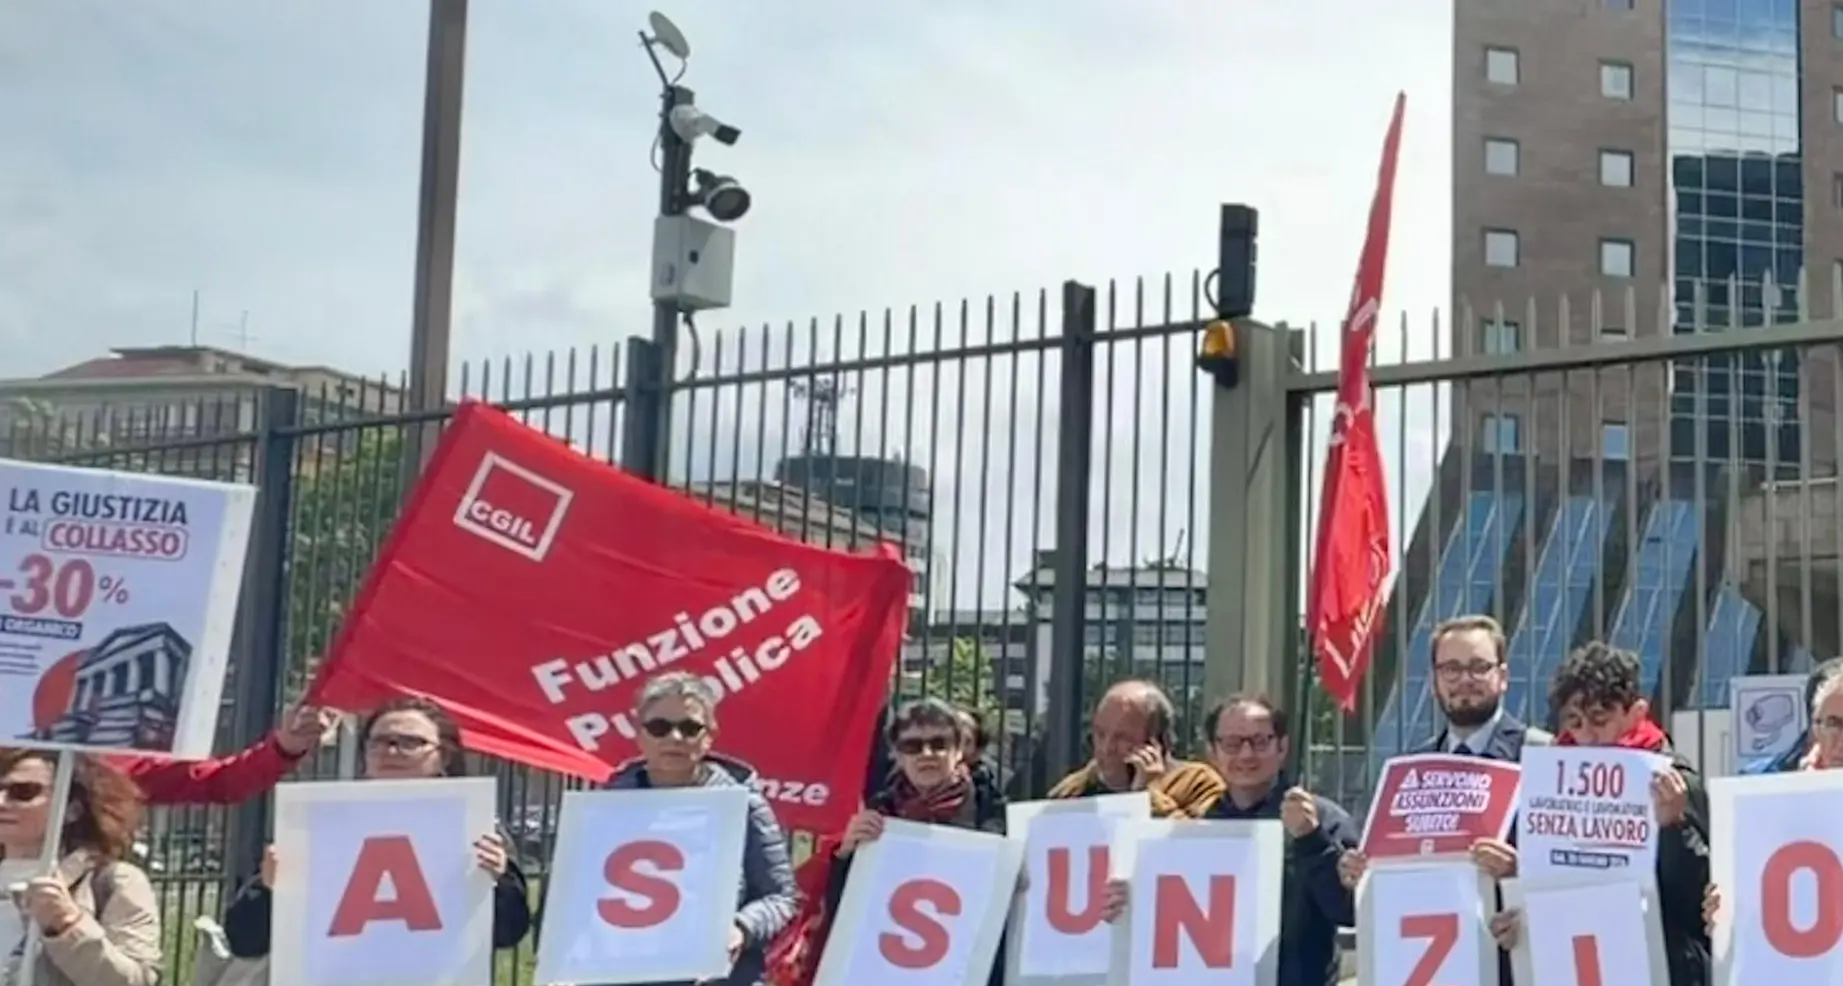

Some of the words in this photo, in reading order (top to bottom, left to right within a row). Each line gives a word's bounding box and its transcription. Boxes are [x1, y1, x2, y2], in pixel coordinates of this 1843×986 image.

[9, 488, 40, 513] LA
[52, 491, 187, 525] GIUSTIZIA
[50, 522, 180, 553] COLLASSO
[470, 500, 537, 546] CGIL
[532, 567, 802, 704] Funzione
[1556, 760, 1624, 798] 1.500
[1527, 812, 1577, 838] SENZA
[1583, 818, 1649, 843] LAVORO
[326, 835, 444, 937] A
[596, 840, 685, 928] S
[878, 878, 962, 969] S
[1046, 845, 1110, 935] U
[1153, 874, 1236, 969] N
